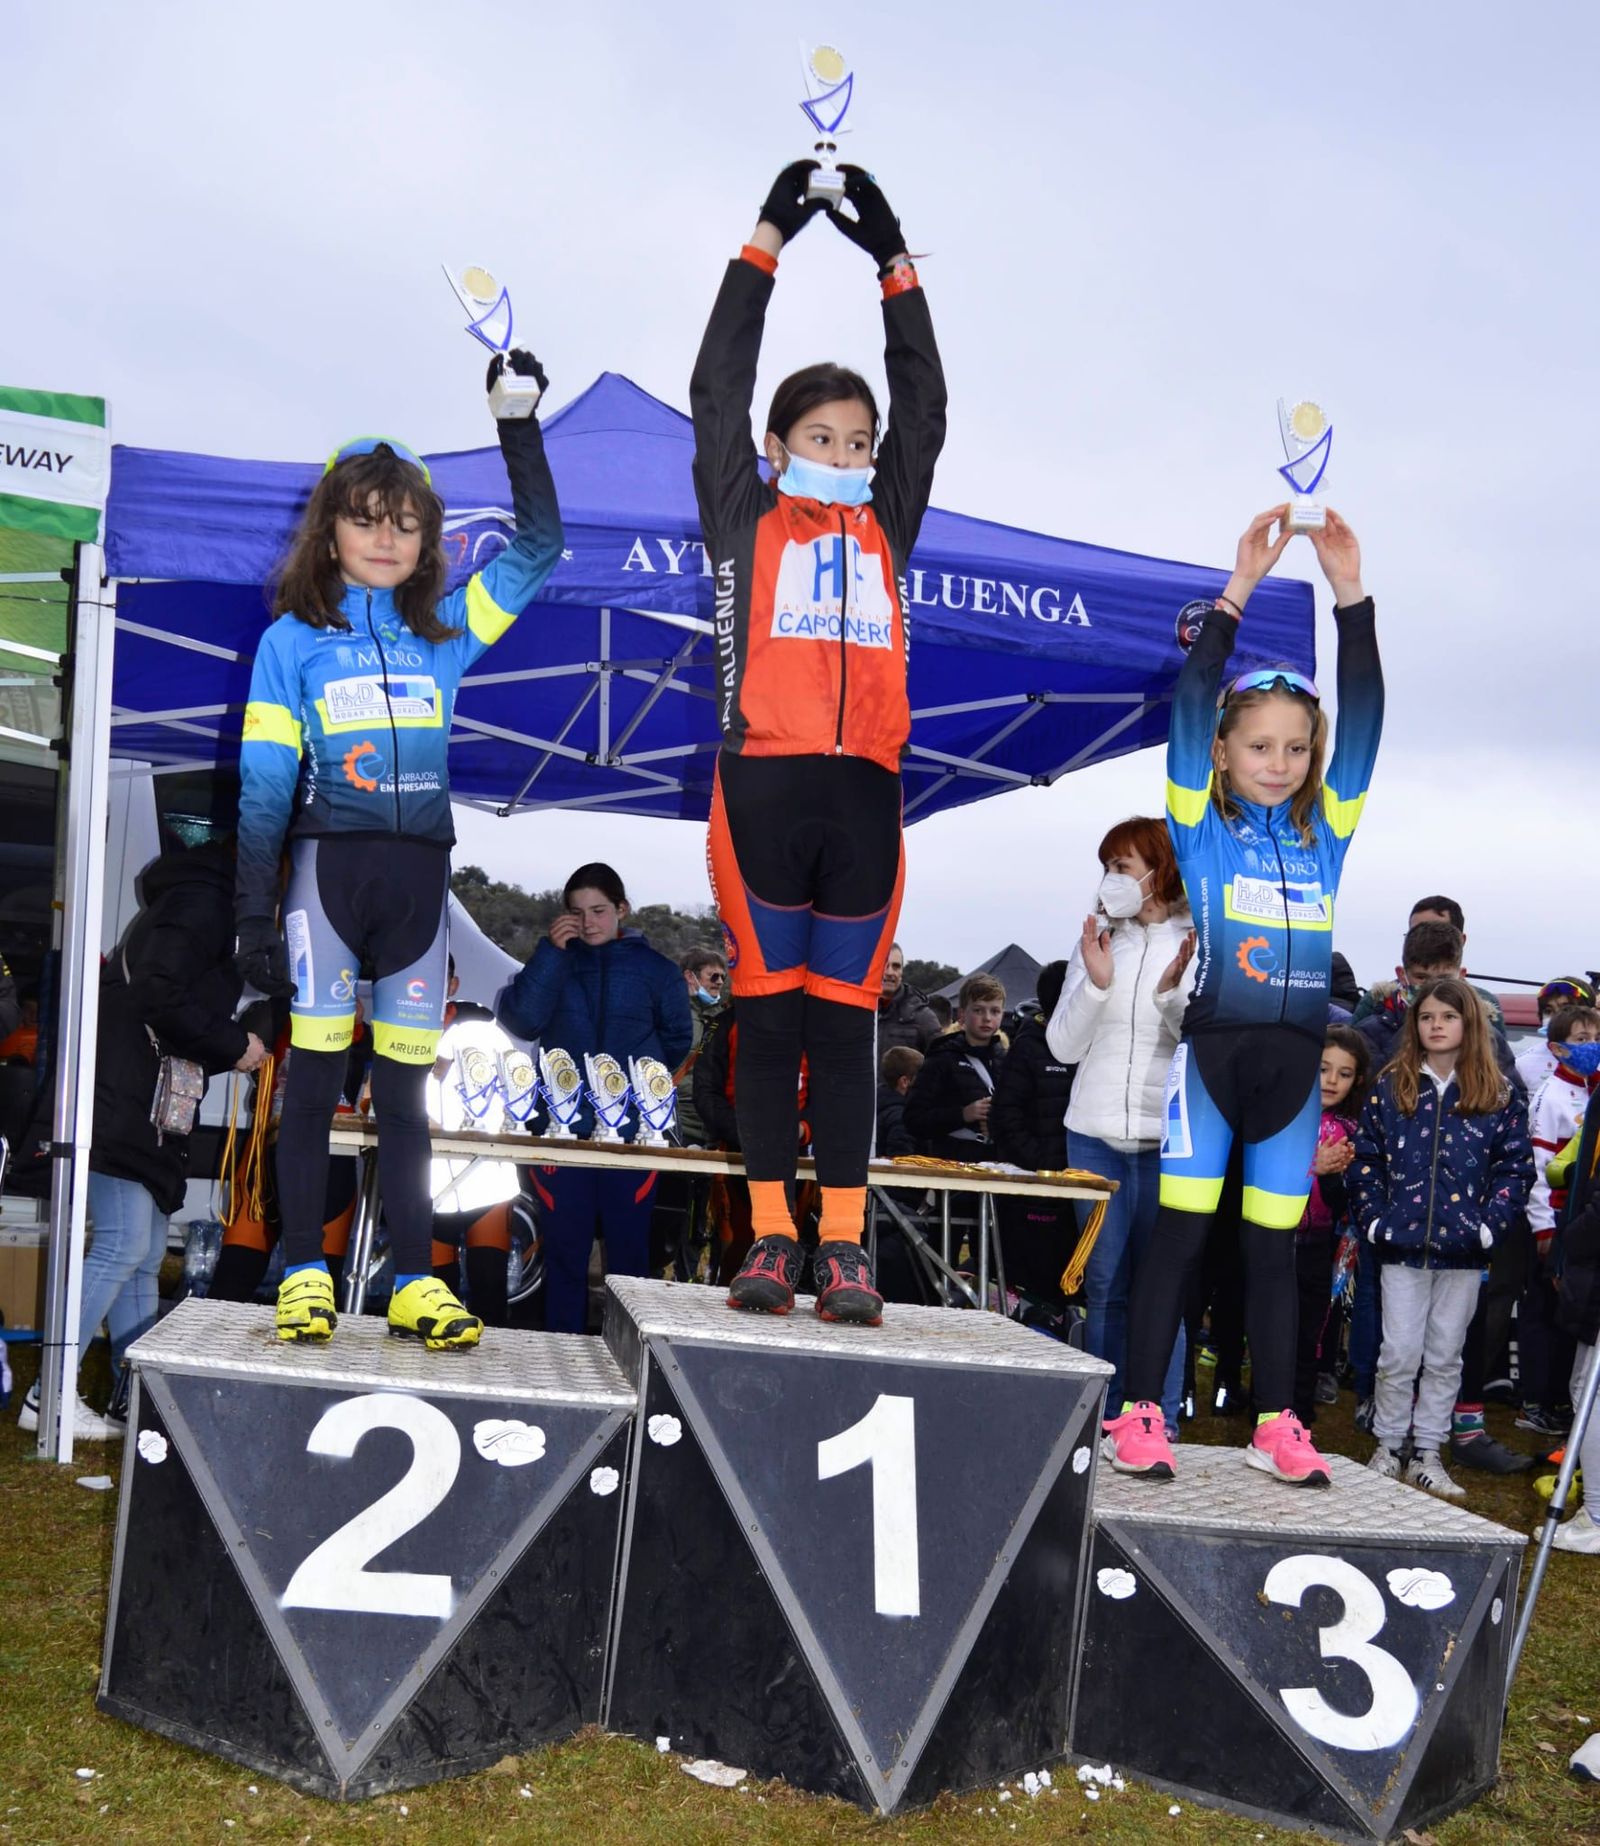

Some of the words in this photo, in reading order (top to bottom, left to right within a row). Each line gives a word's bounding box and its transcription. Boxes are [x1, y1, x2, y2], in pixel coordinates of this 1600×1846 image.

[357, 649, 423, 668] MORO
[715, 557, 736, 732] AVALUENGA
[379, 781, 442, 793] EMPRESARIAL
[1261, 858, 1319, 876] MORO
[389, 1041, 432, 1056] ARRUEDA
[279, 1392, 463, 1618] 2
[817, 1393, 921, 1618] 1
[1263, 1553, 1420, 1752] 3
